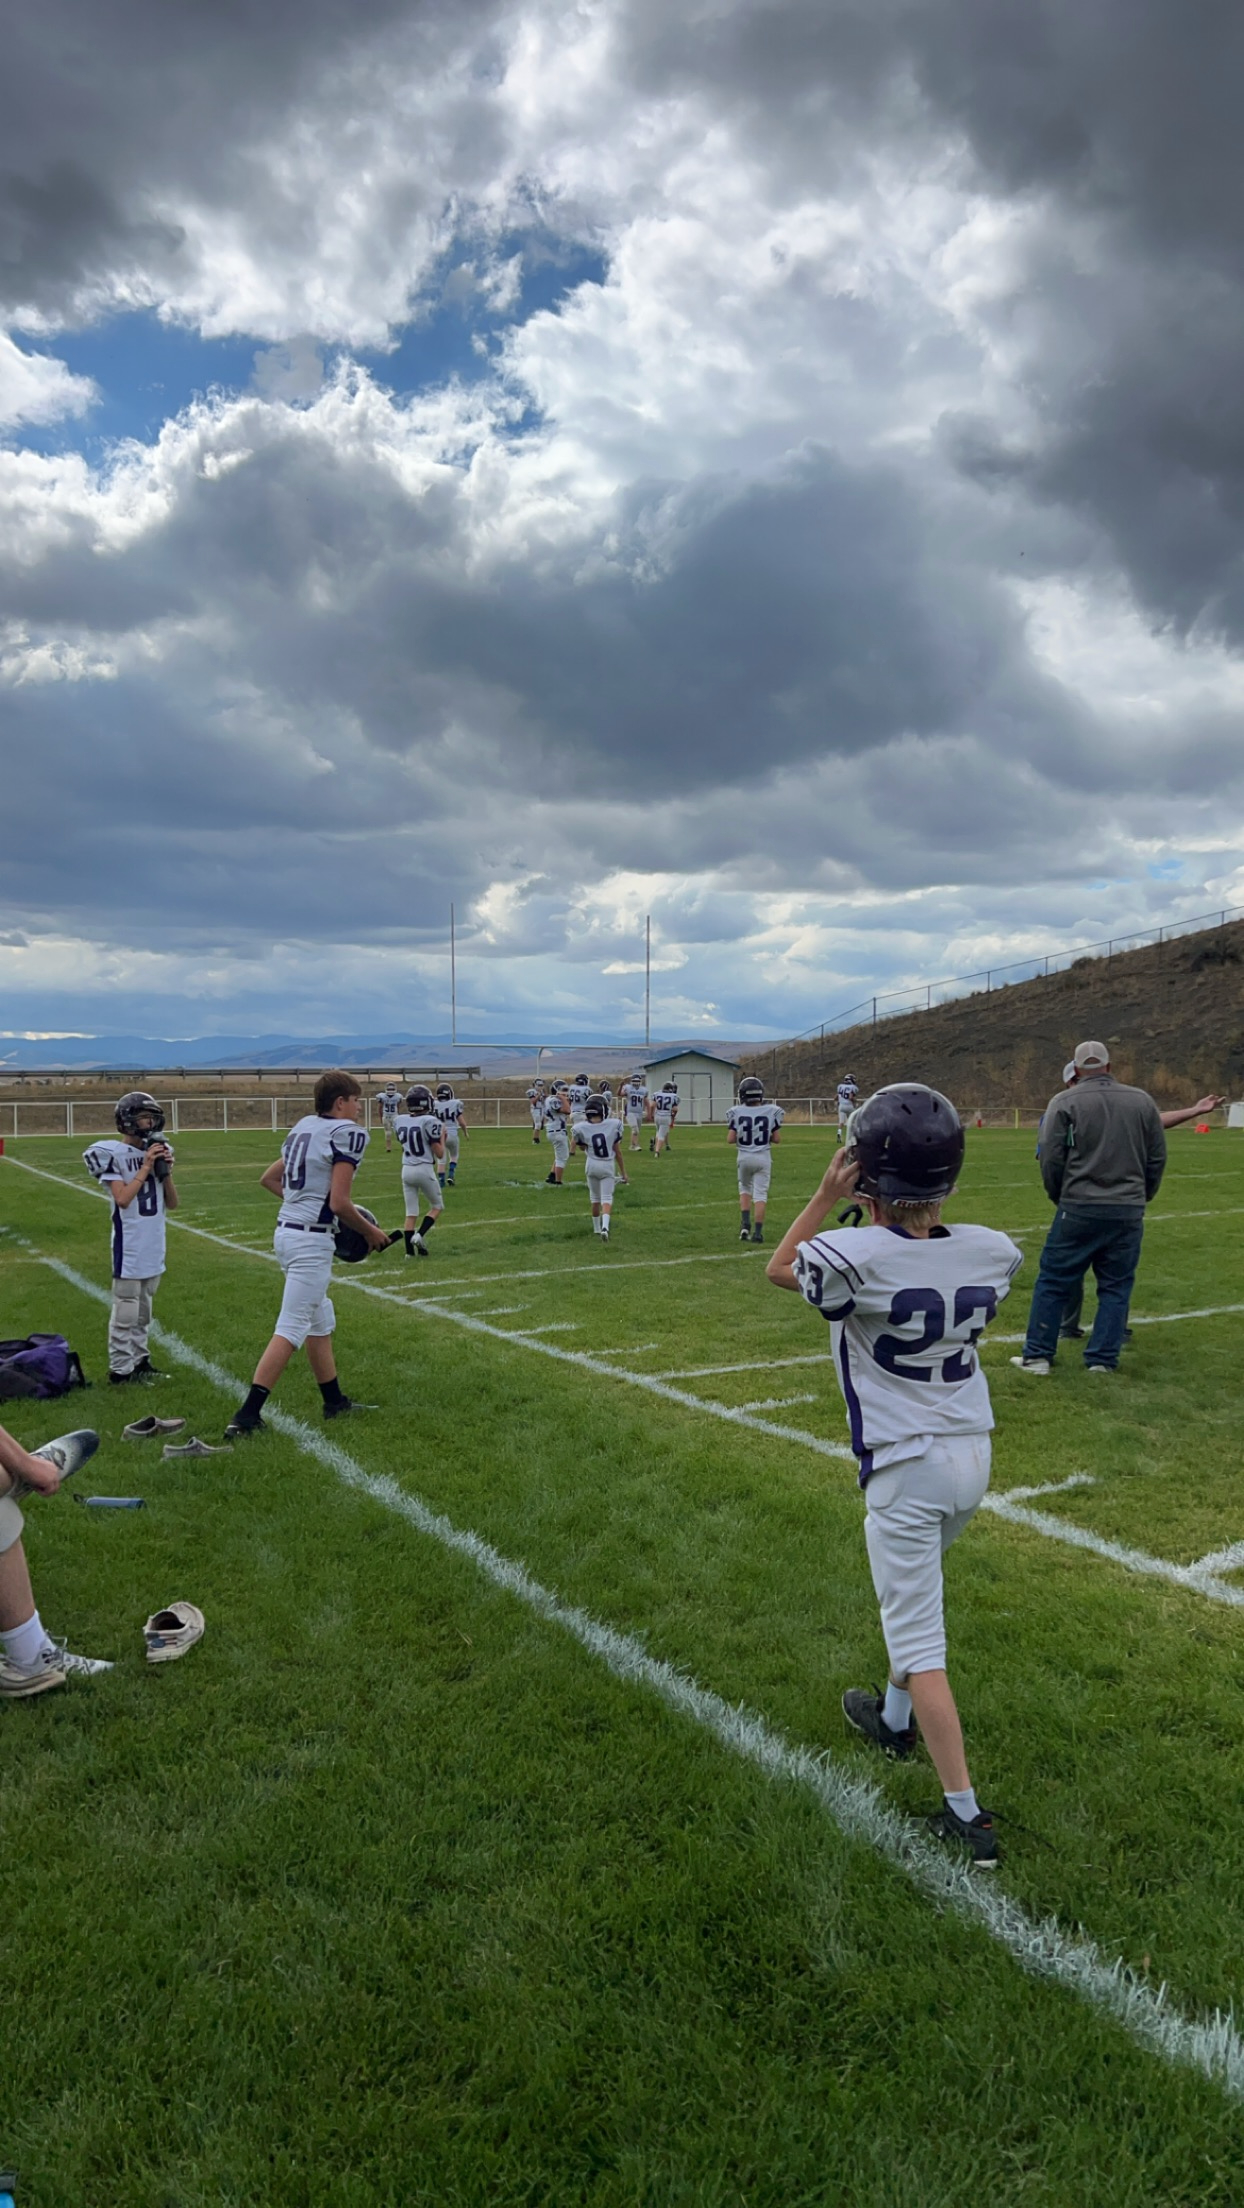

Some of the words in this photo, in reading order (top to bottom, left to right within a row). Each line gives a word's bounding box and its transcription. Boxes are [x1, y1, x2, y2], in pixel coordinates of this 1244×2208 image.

[631, 1096, 643, 1108] 84
[656, 1095, 671, 1110] 32
[348, 1131, 366, 1153] 10
[398, 1126, 425, 1157] 20
[738, 1116, 769, 1146] 33
[592, 1133, 609, 1158] 8
[282, 1133, 312, 1190] 10
